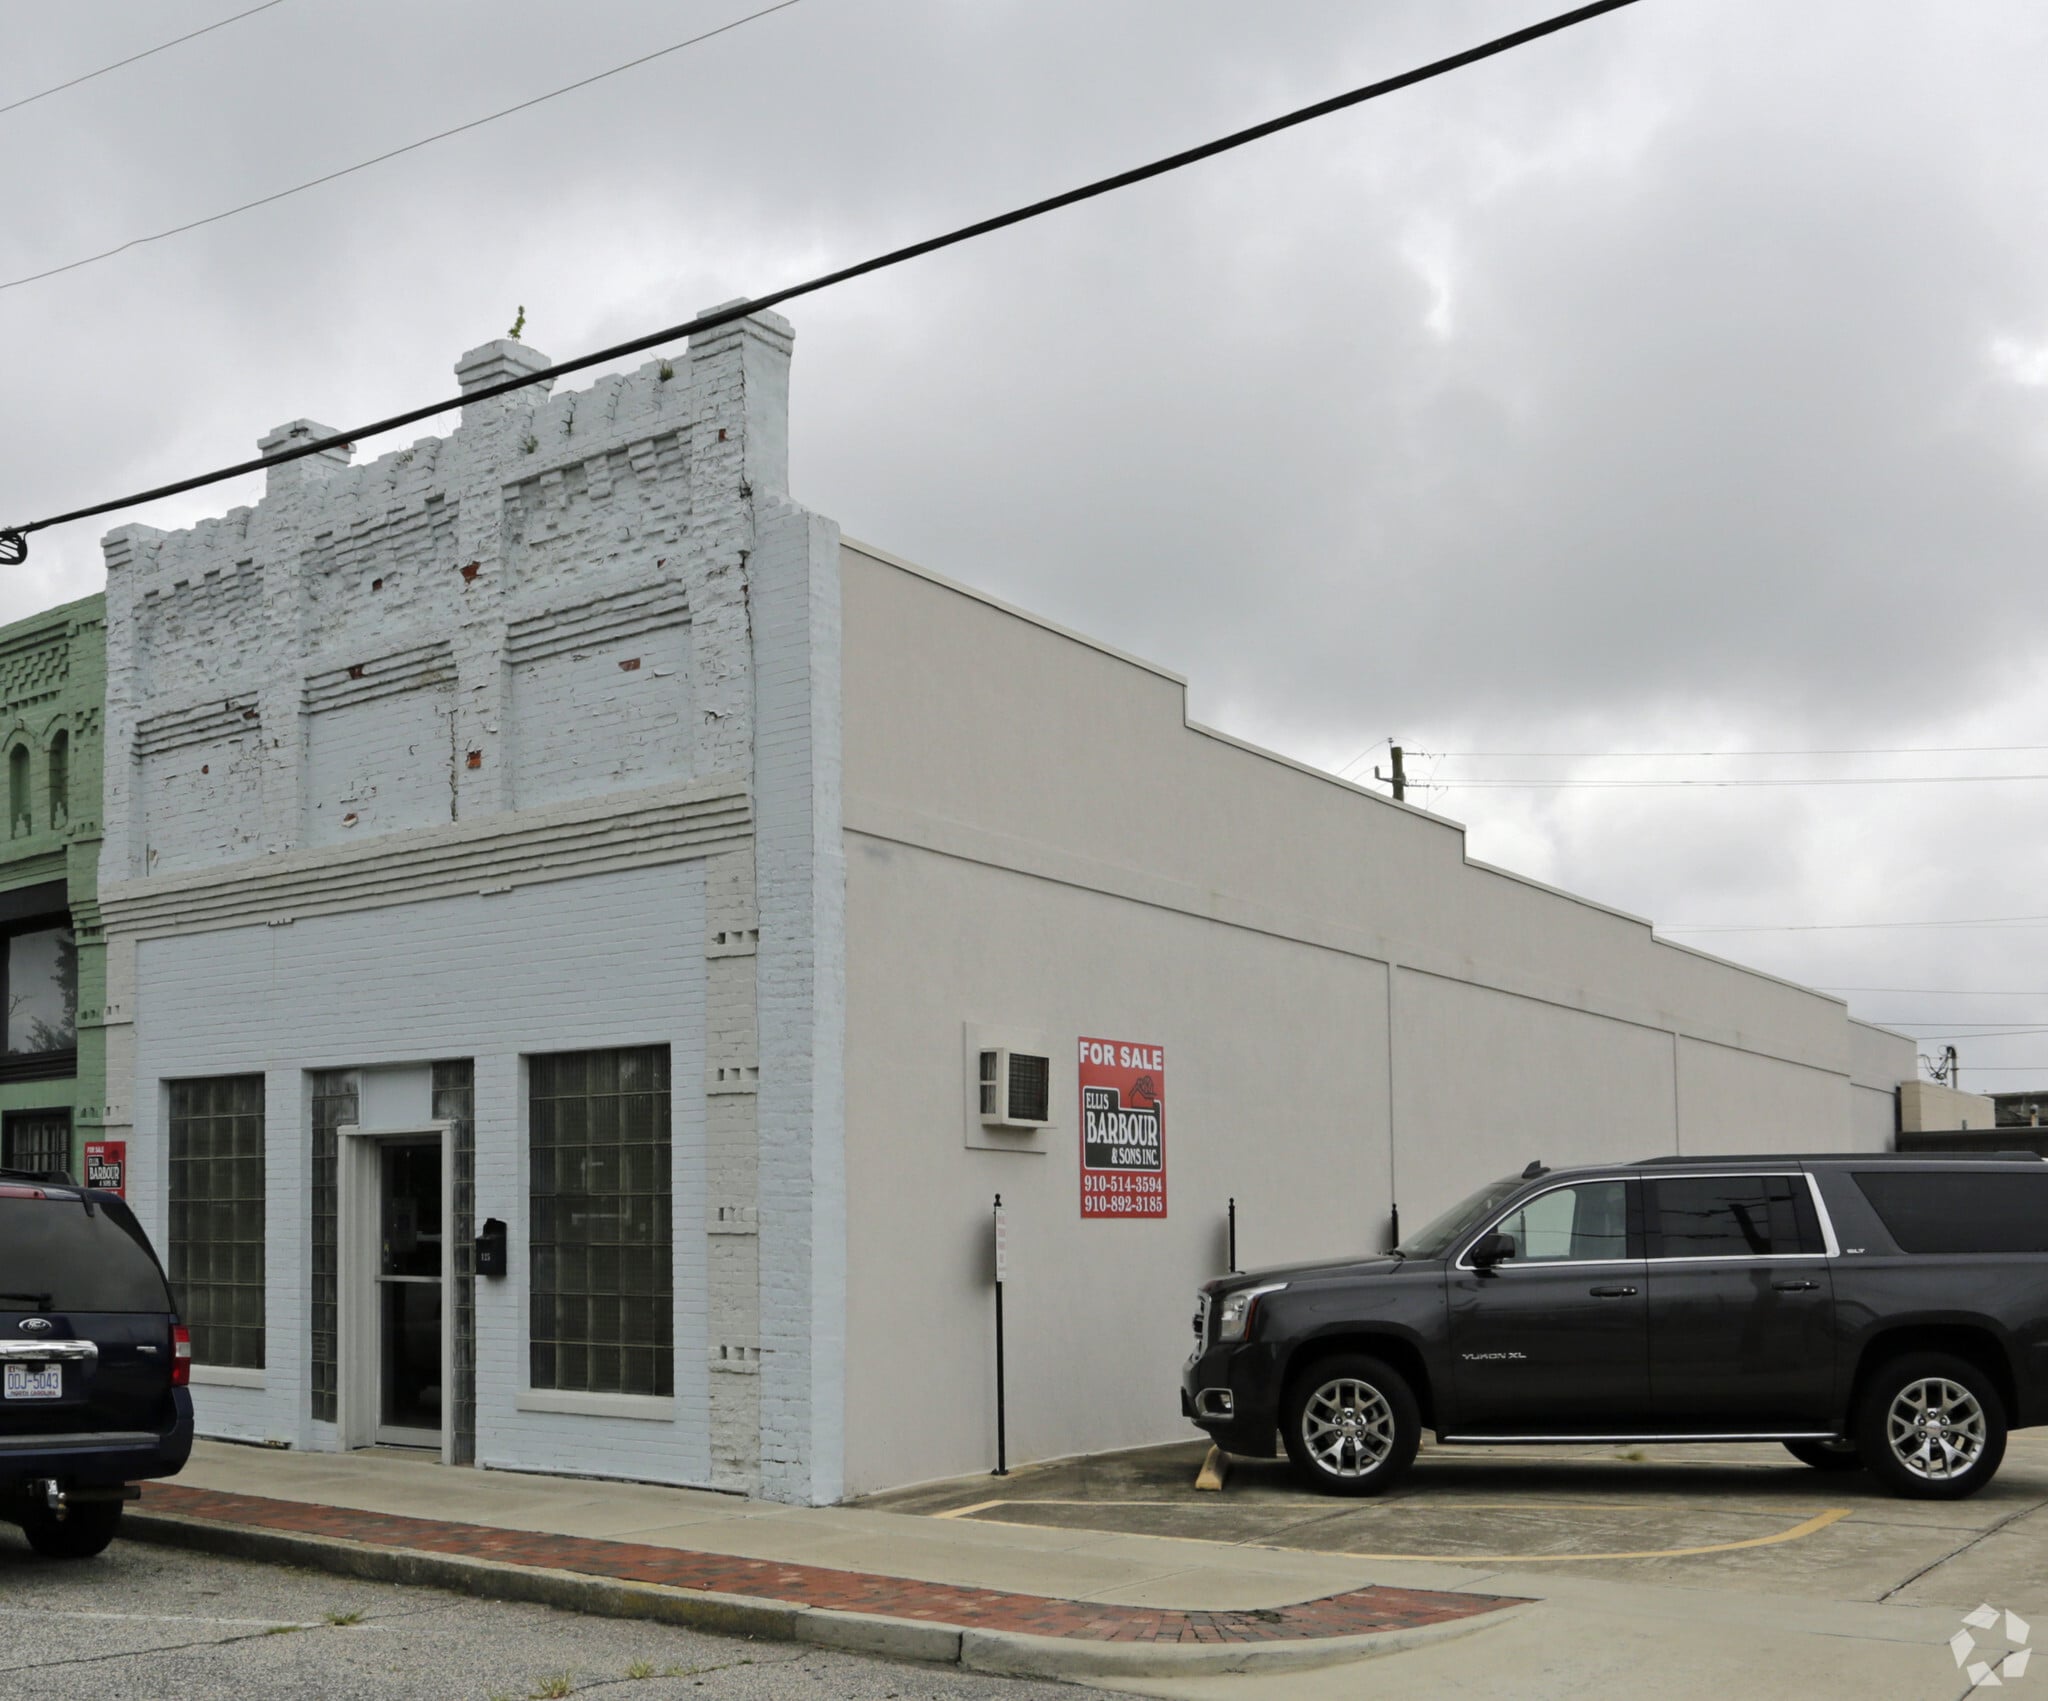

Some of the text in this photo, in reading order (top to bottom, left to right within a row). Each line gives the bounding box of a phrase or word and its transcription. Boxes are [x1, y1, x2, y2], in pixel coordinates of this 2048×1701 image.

[1079, 1041, 1163, 1071] FOR SALE
[1086, 1092, 1109, 1110] ELLIS
[1086, 1111, 1158, 1147] BARBOUR
[1111, 1147, 1159, 1166] & SONS INC.
[89, 1166, 120, 1180] BARBOUR
[1084, 1175, 1162, 1193] 910-514-3594
[1085, 1195, 1163, 1213] 910-892-3185
[1462, 1351, 1527, 1360] YUKON XL
